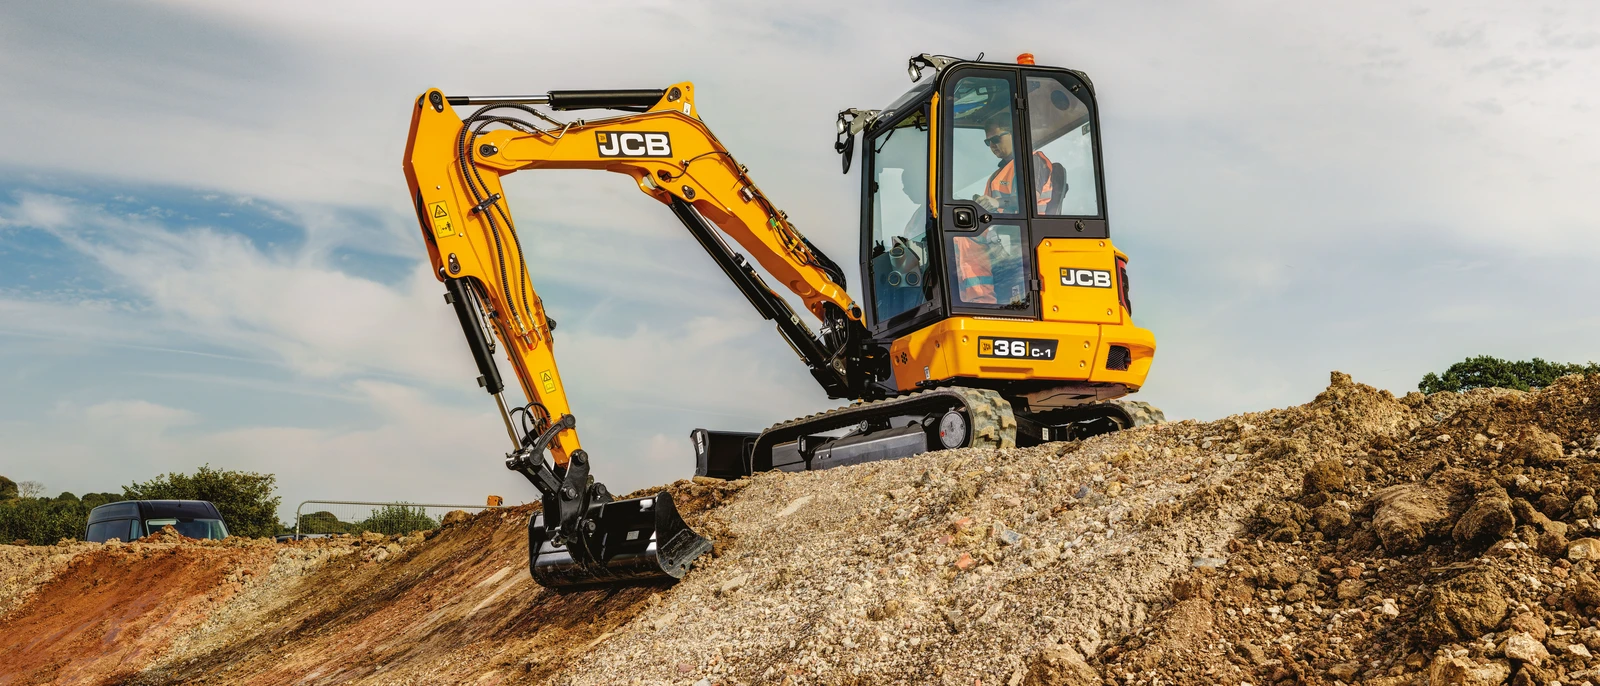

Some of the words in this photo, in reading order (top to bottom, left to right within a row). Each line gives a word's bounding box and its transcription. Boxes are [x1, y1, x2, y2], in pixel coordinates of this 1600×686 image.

[599, 133, 671, 156] JCB
[1061, 269, 1111, 287] JCB
[994, 339, 1026, 357] 36
[1031, 348, 1051, 358] C-1
